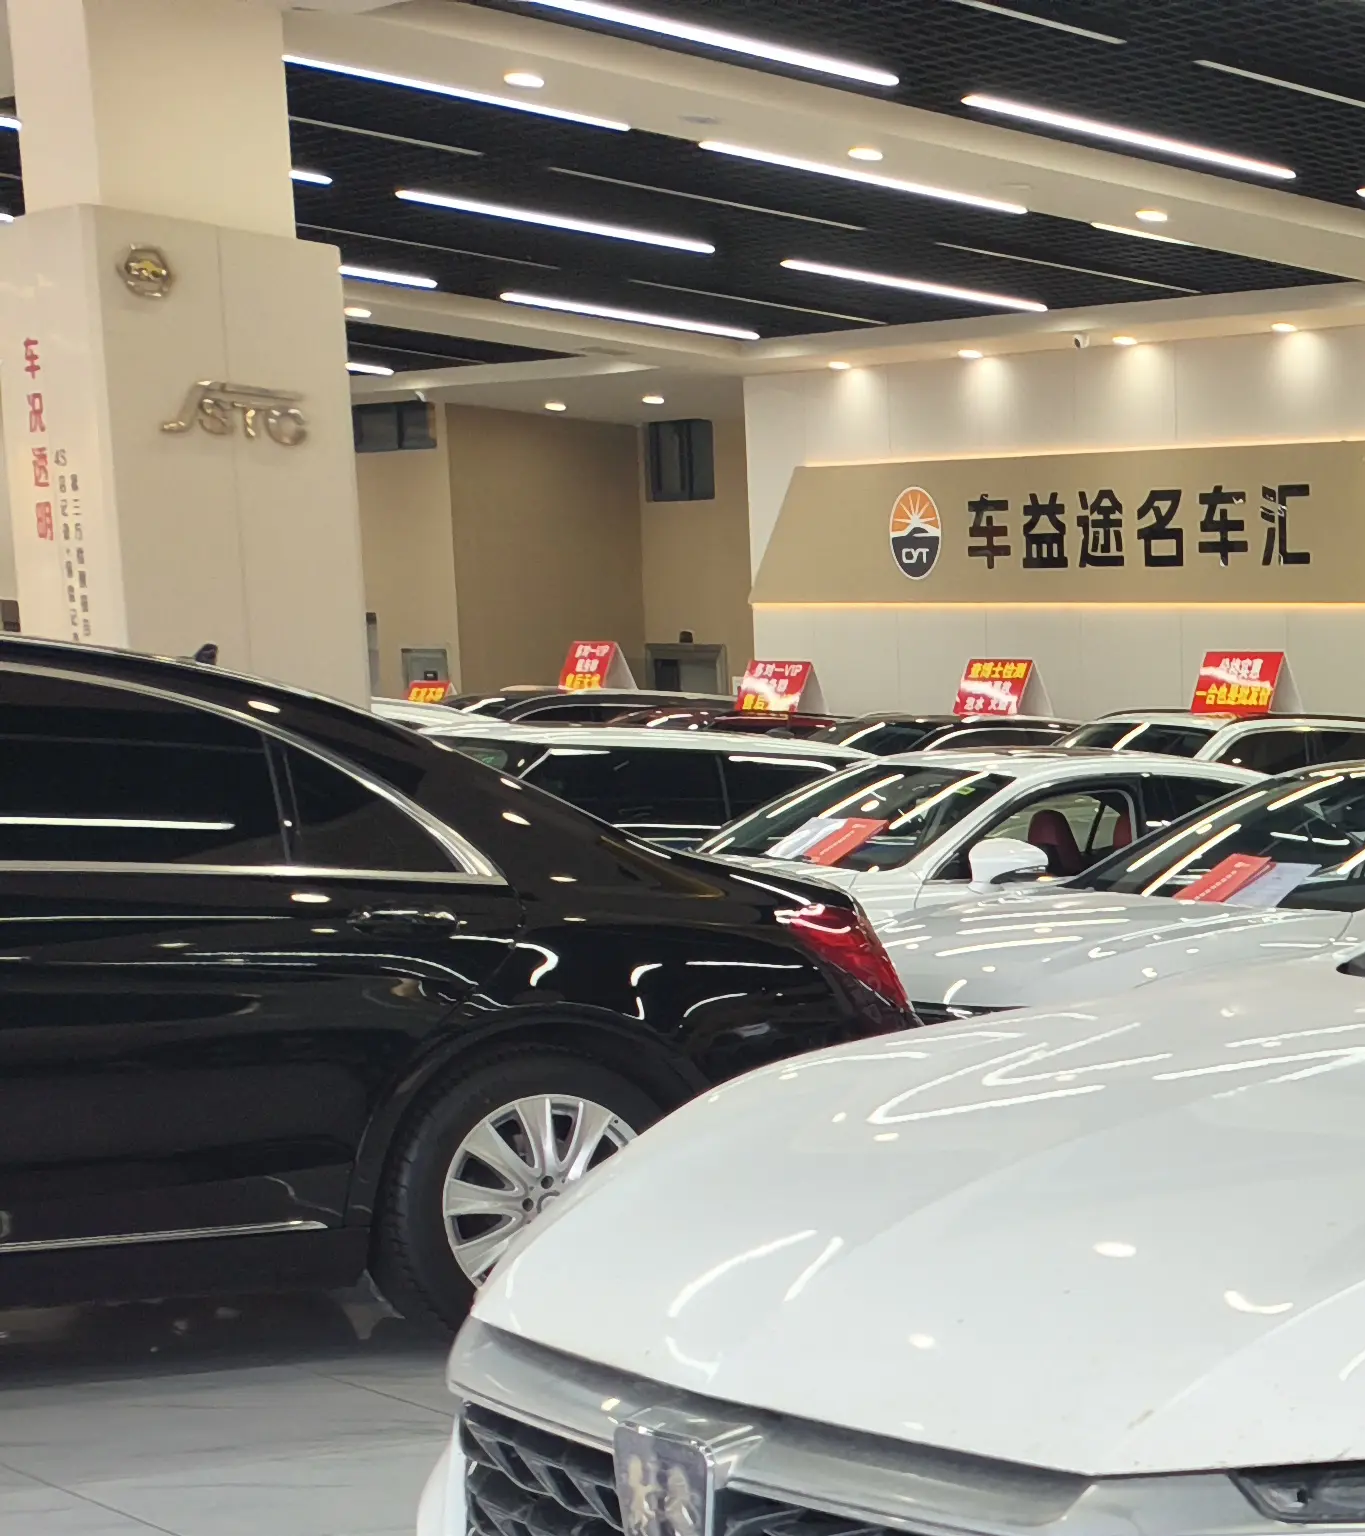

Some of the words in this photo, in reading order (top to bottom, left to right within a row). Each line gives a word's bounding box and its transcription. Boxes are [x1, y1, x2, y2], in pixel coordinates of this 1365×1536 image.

[967, 483, 1310, 570] 车益途名车汇
